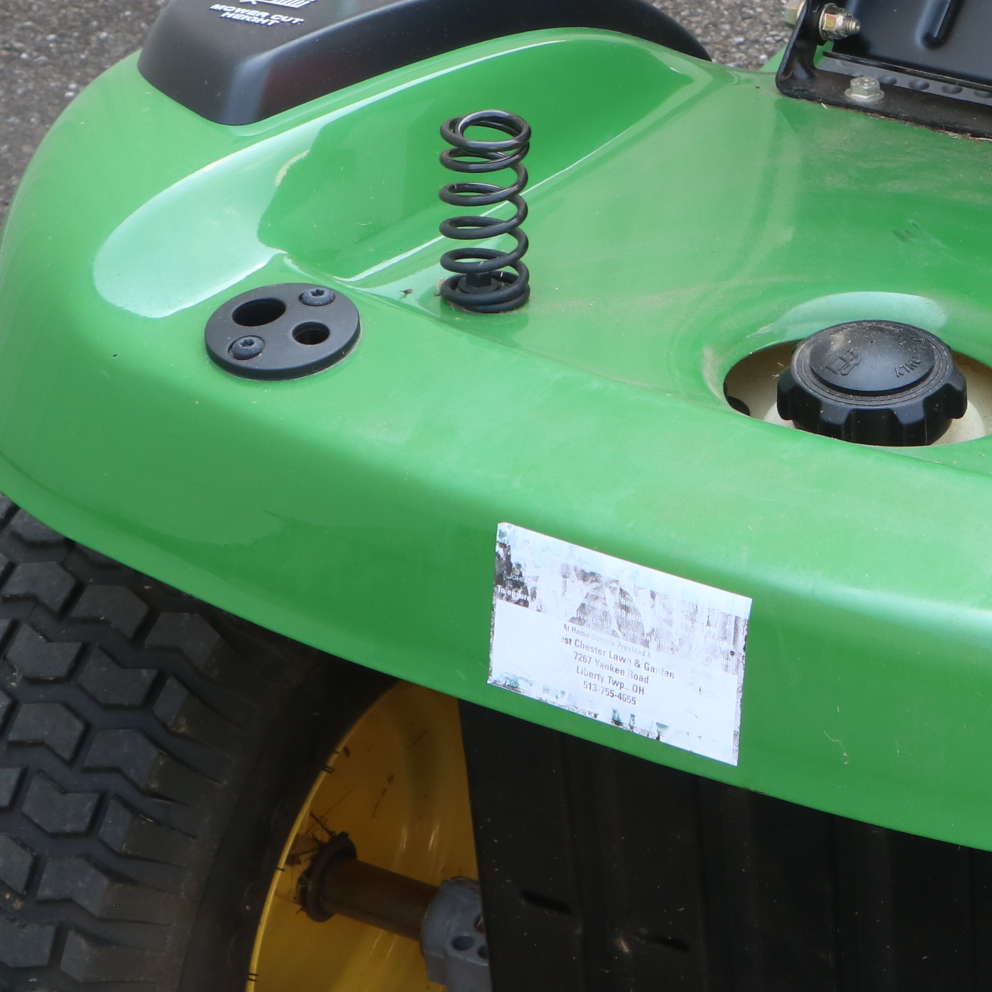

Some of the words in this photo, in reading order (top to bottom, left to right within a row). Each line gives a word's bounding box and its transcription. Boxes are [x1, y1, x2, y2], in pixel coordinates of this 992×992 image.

[209, 4, 270, 18] MOWER
[220, 12, 280, 26] HEIGHT
[574, 639, 607, 657] Chester
[608, 650, 632, 665] Lawn
[634, 659, 641, 669] &
[573, 651, 592, 665] 7267
[595, 658, 626, 676] Yankee
[632, 684, 645, 695] OH
